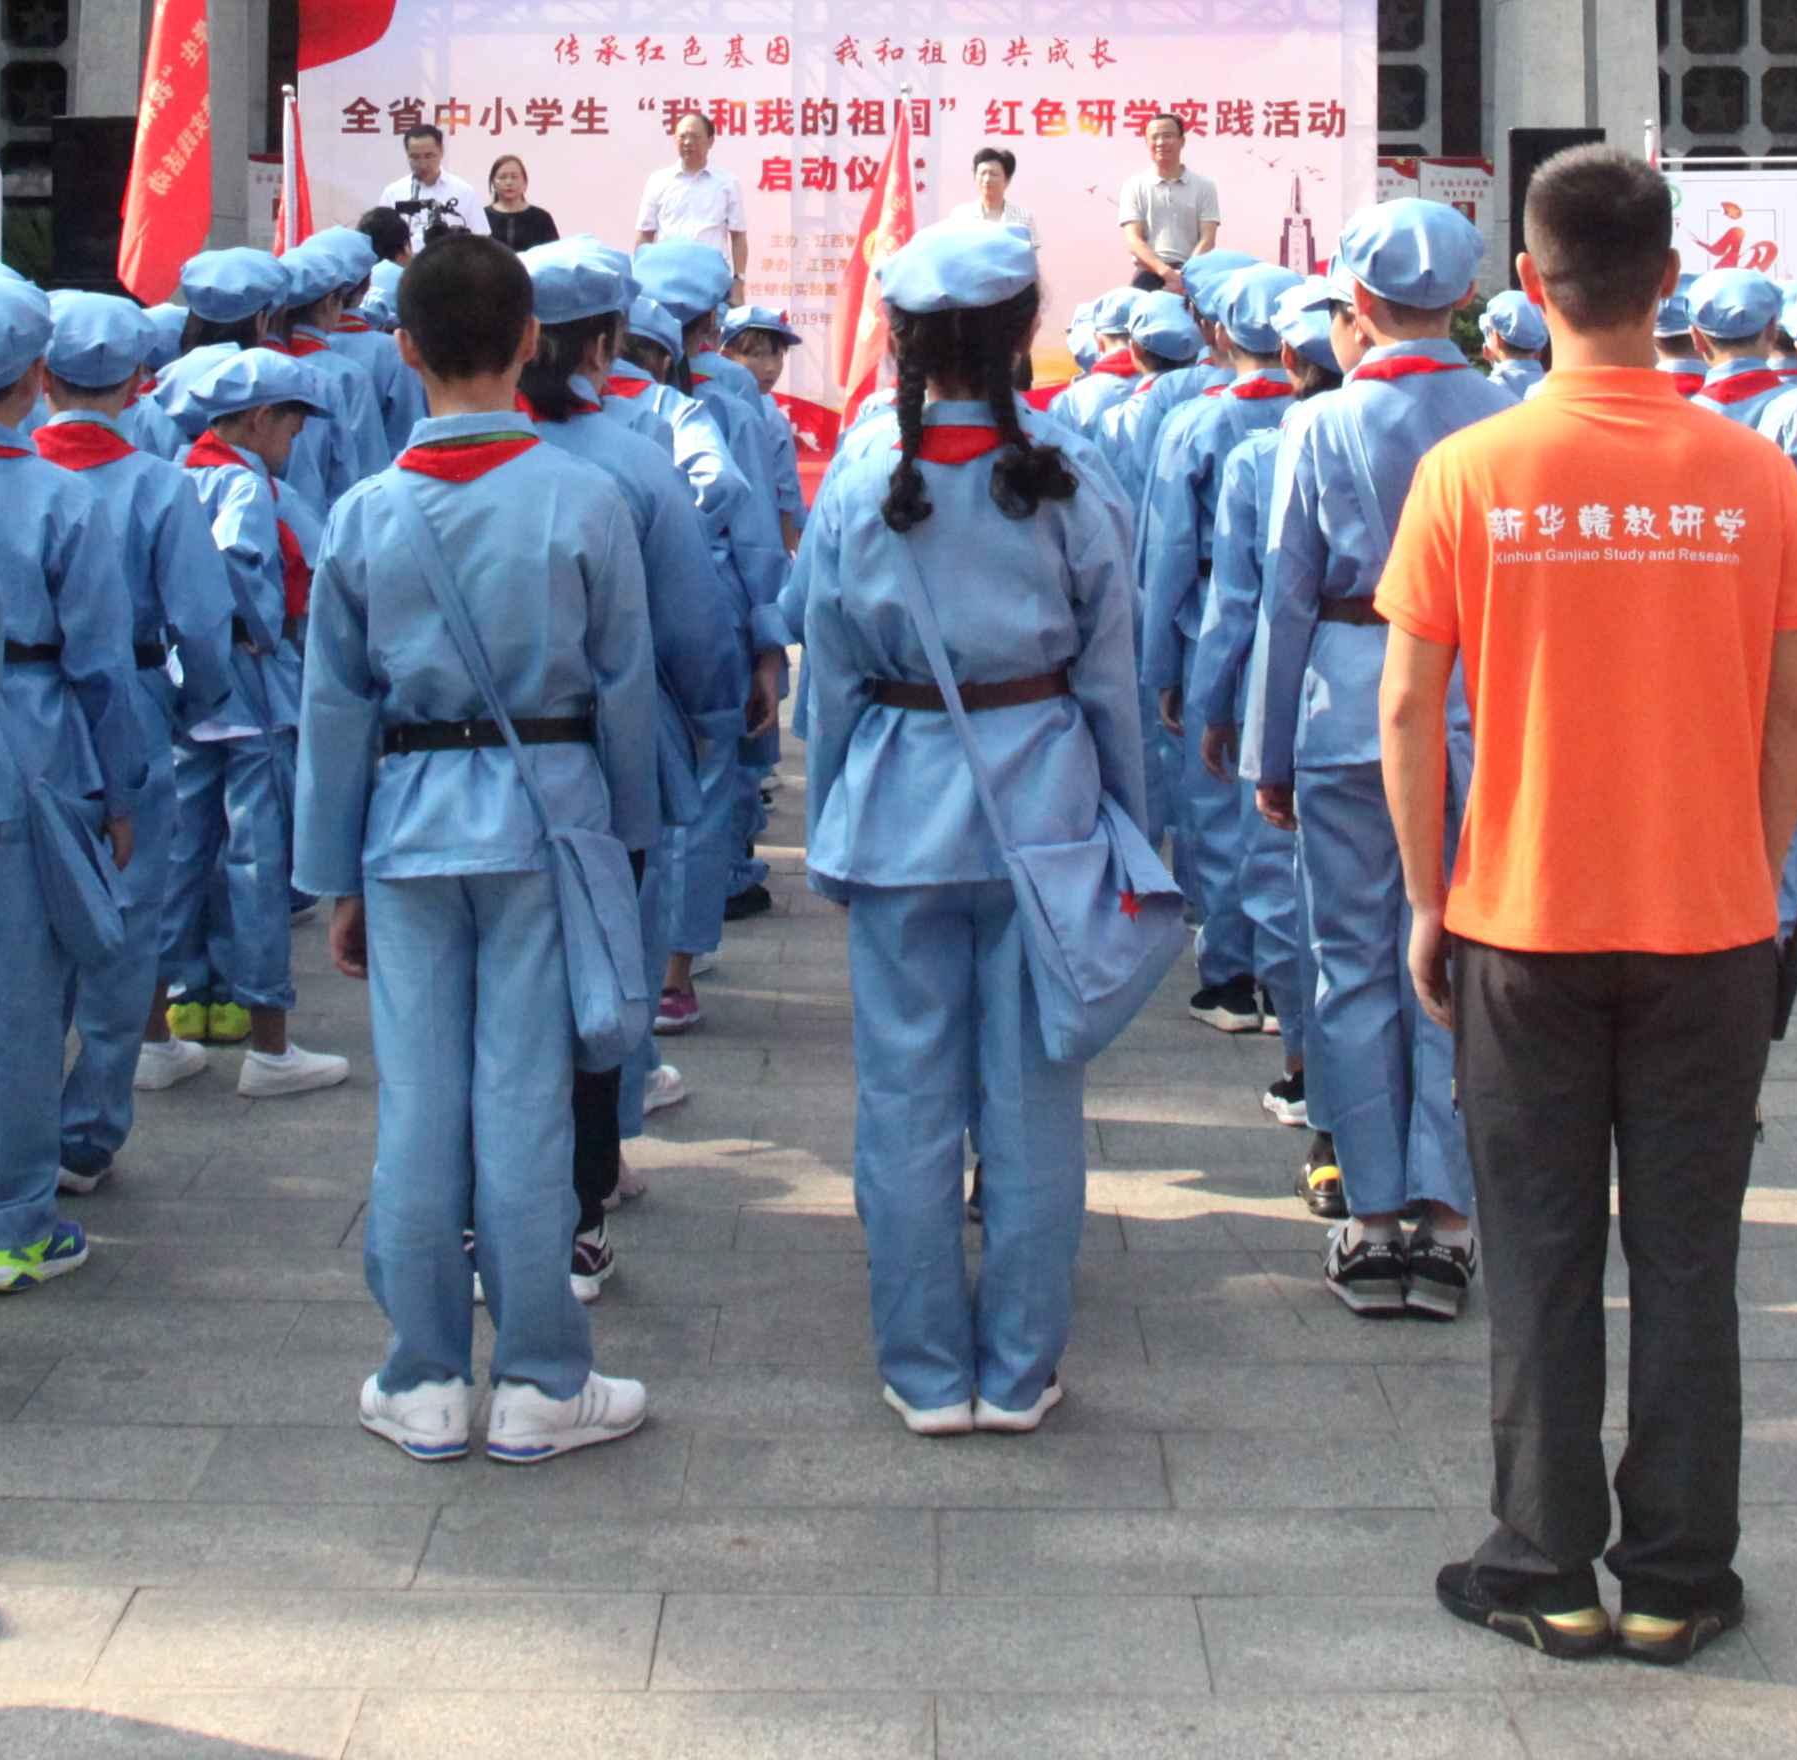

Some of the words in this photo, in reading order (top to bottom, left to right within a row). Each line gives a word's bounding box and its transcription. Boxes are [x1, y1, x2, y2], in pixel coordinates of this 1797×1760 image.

[555, 33, 791, 69] 传承红色基因
[832, 34, 1119, 68] 我和祖国共成长
[757, 155, 926, 192] 启动仪
[1494, 550, 1541, 565] Xinhua
[1545, 548, 1600, 564] Ganjiao
[1603, 547, 1644, 563] Study
[1648, 548, 1676, 561] and
